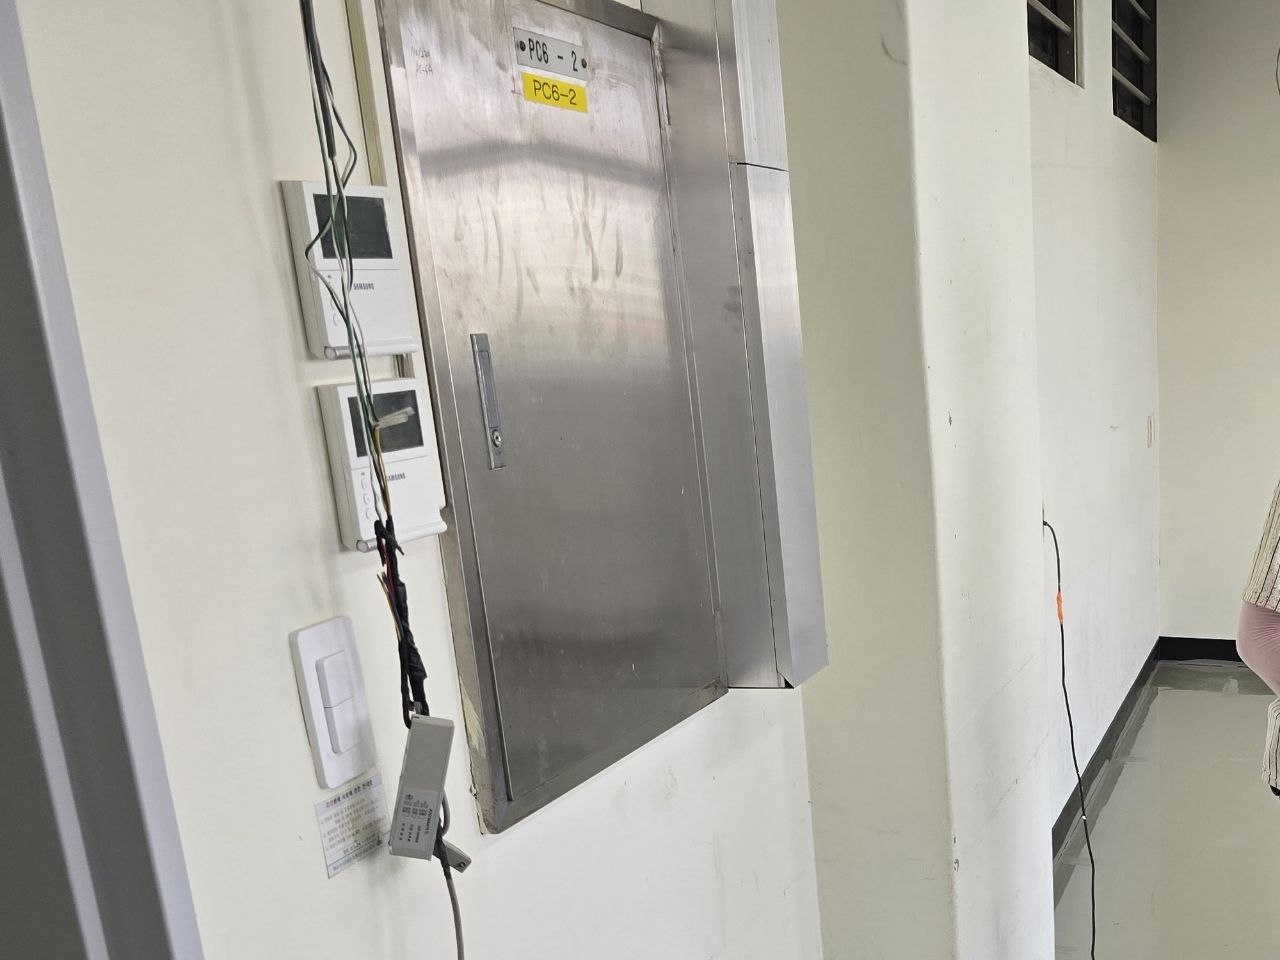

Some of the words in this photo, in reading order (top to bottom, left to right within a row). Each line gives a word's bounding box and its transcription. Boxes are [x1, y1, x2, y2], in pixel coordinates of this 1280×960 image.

[528, 38, 549, 64] PC6
[571, 50, 578, 72] 2
[533, 79, 577, 106] PC6-2
[353, 282, 375, 291] SAMSUNG
[387, 472, 406, 482] AMSUNG
